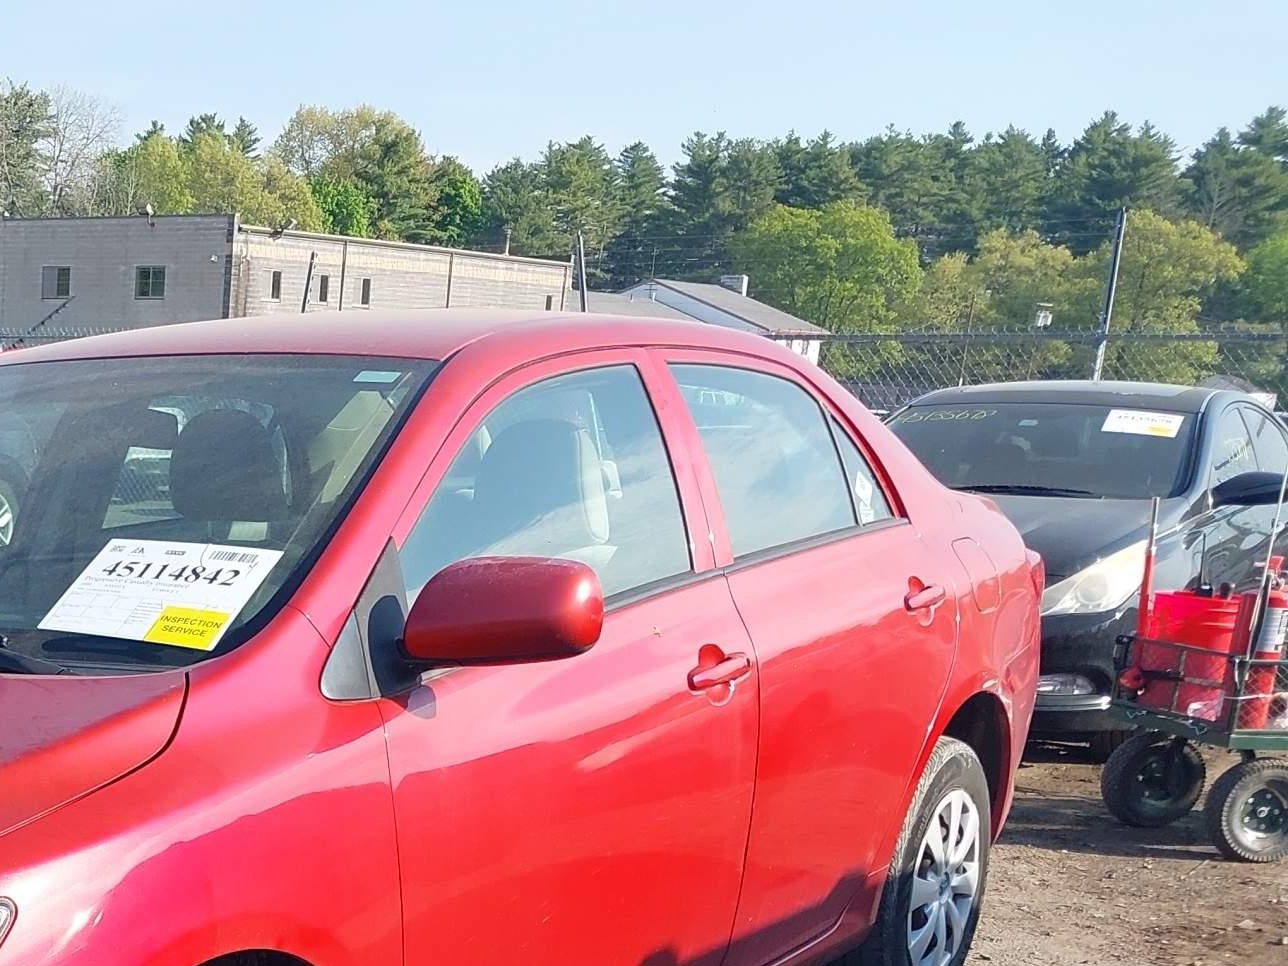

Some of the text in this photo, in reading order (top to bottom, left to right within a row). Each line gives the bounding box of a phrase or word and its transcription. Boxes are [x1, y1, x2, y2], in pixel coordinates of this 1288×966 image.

[102, 561, 241, 586] 45114842
[160, 615, 223, 629] INSPECTION
[162, 625, 208, 637] SERVICE
